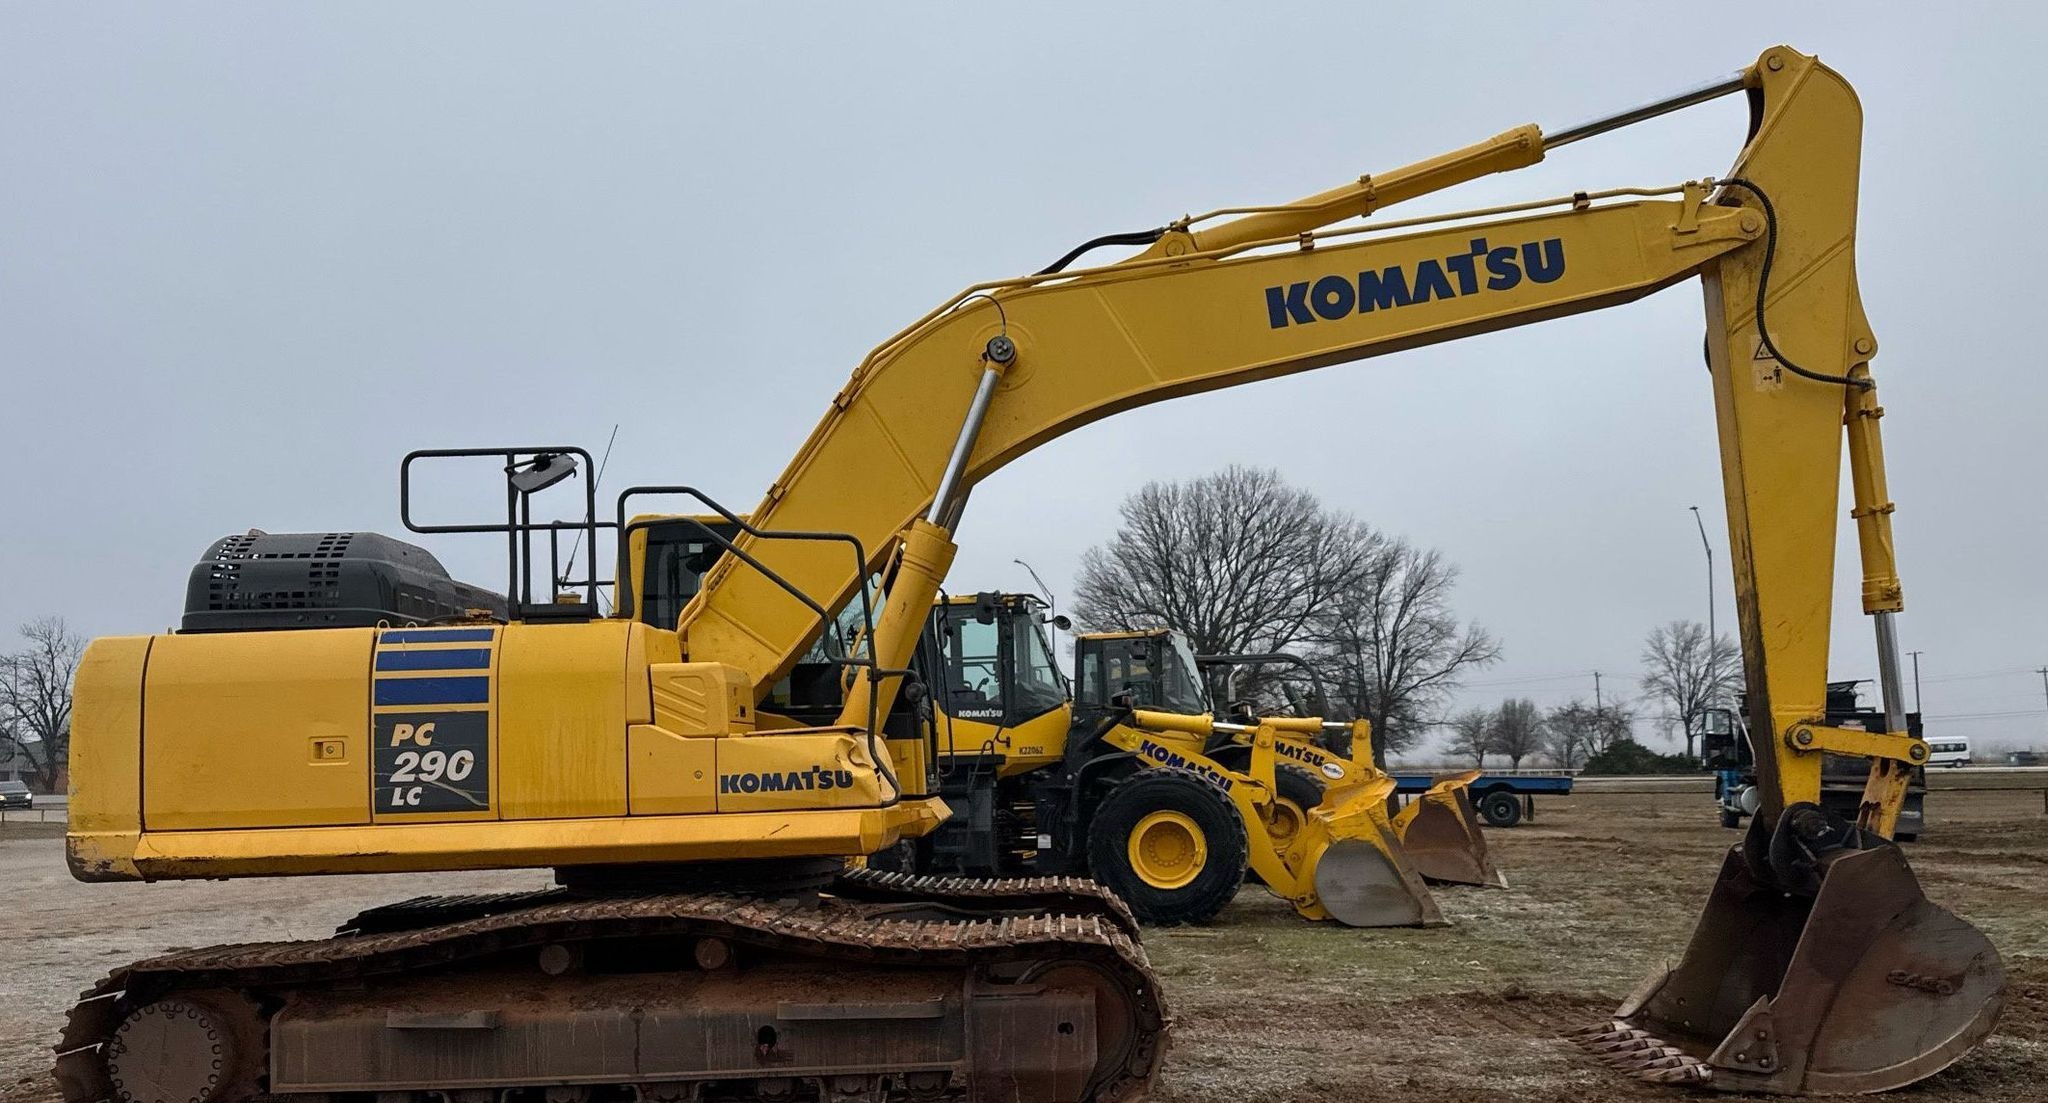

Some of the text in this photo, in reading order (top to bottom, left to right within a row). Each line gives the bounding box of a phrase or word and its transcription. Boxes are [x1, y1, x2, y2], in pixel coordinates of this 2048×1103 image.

[1265, 237, 1566, 329] KOMATSU
[958, 708, 1004, 718] KOMATSU
[390, 722, 435, 747] PC
[389, 749, 475, 783] 290
[1275, 740, 1325, 767] MATSU
[720, 765, 854, 794] KOMATSU
[391, 786, 423, 806] LC
